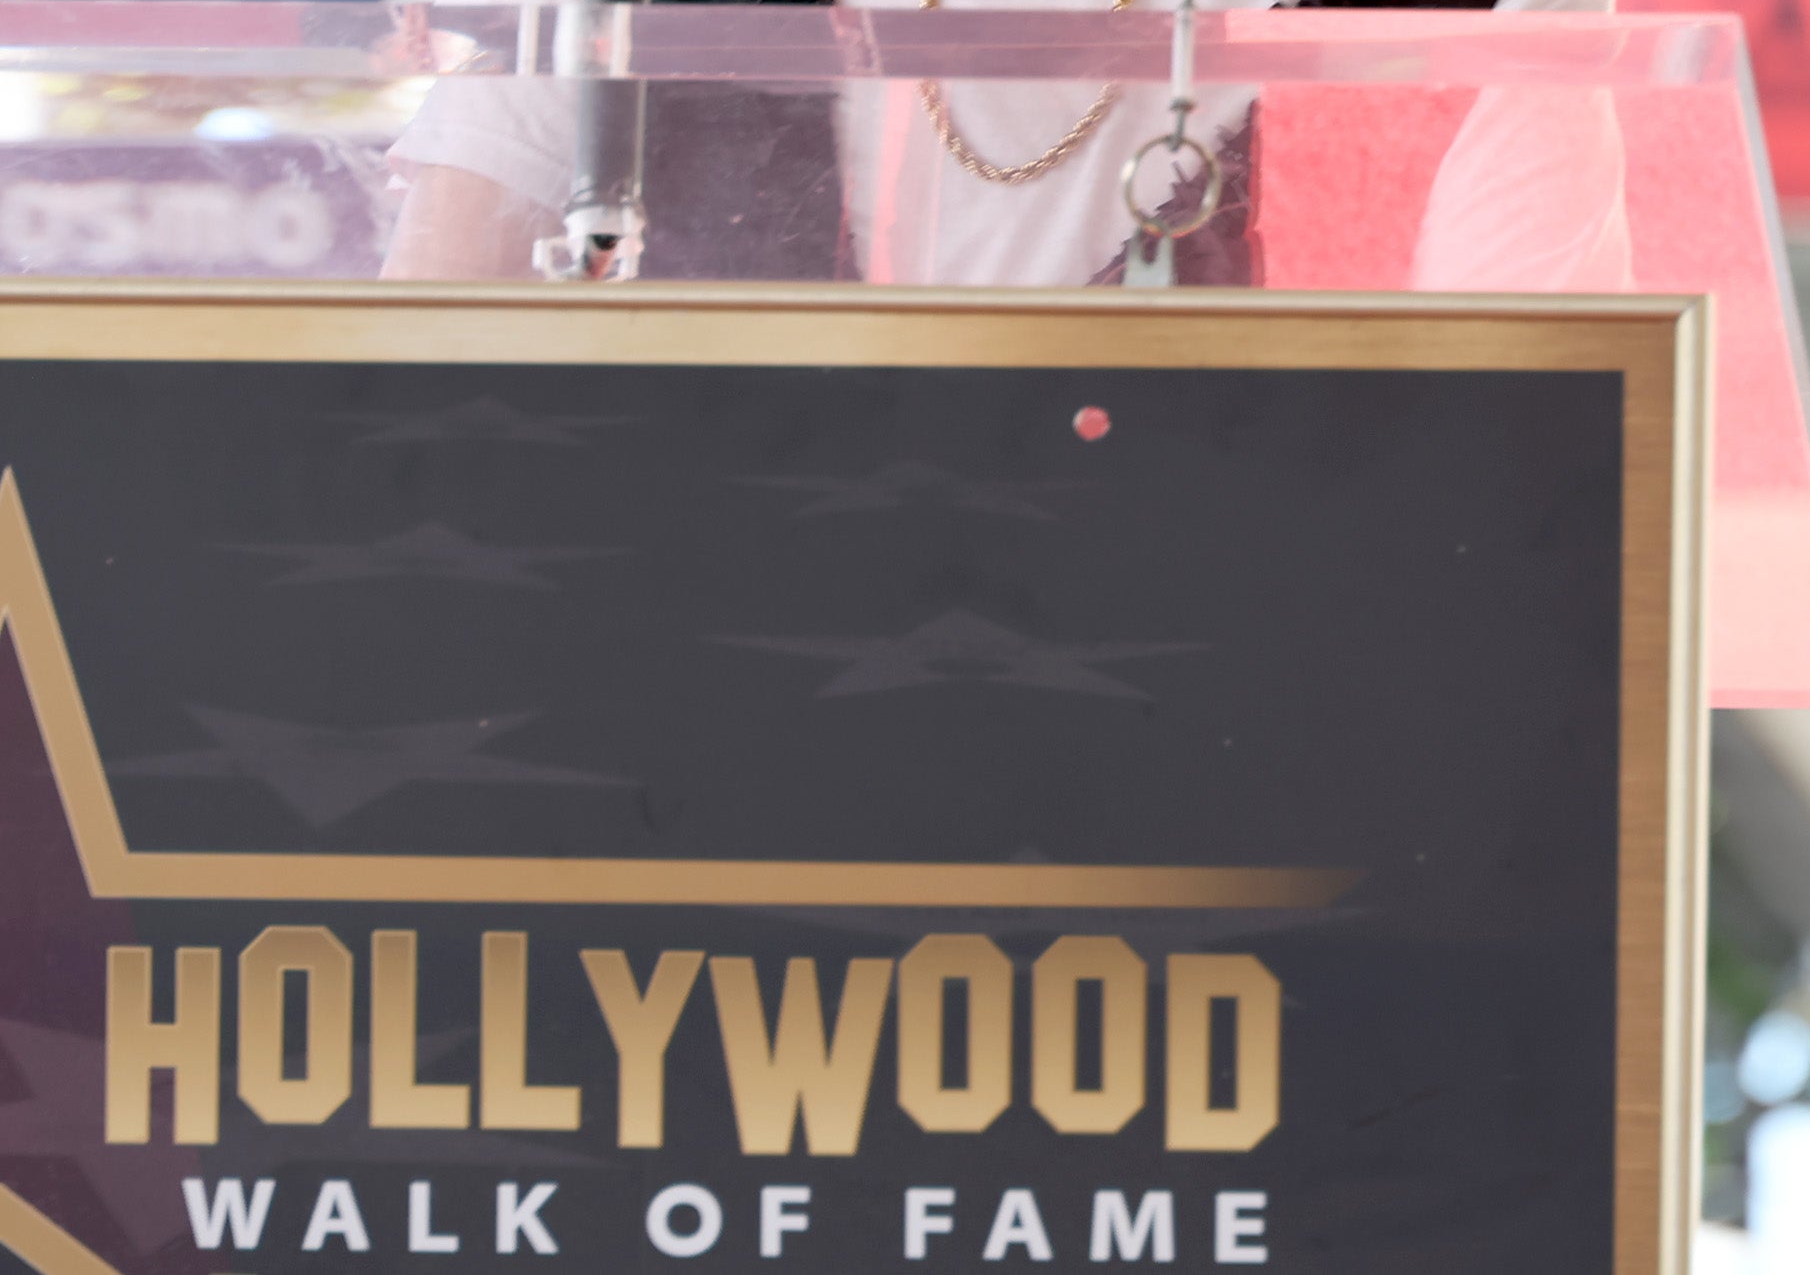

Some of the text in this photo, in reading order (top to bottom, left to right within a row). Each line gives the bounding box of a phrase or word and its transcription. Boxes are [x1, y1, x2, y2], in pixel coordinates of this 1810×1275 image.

[105, 925, 1281, 1156] HOLLYWOOD
[181, 1177, 1268, 1264] WALK OF FAME
